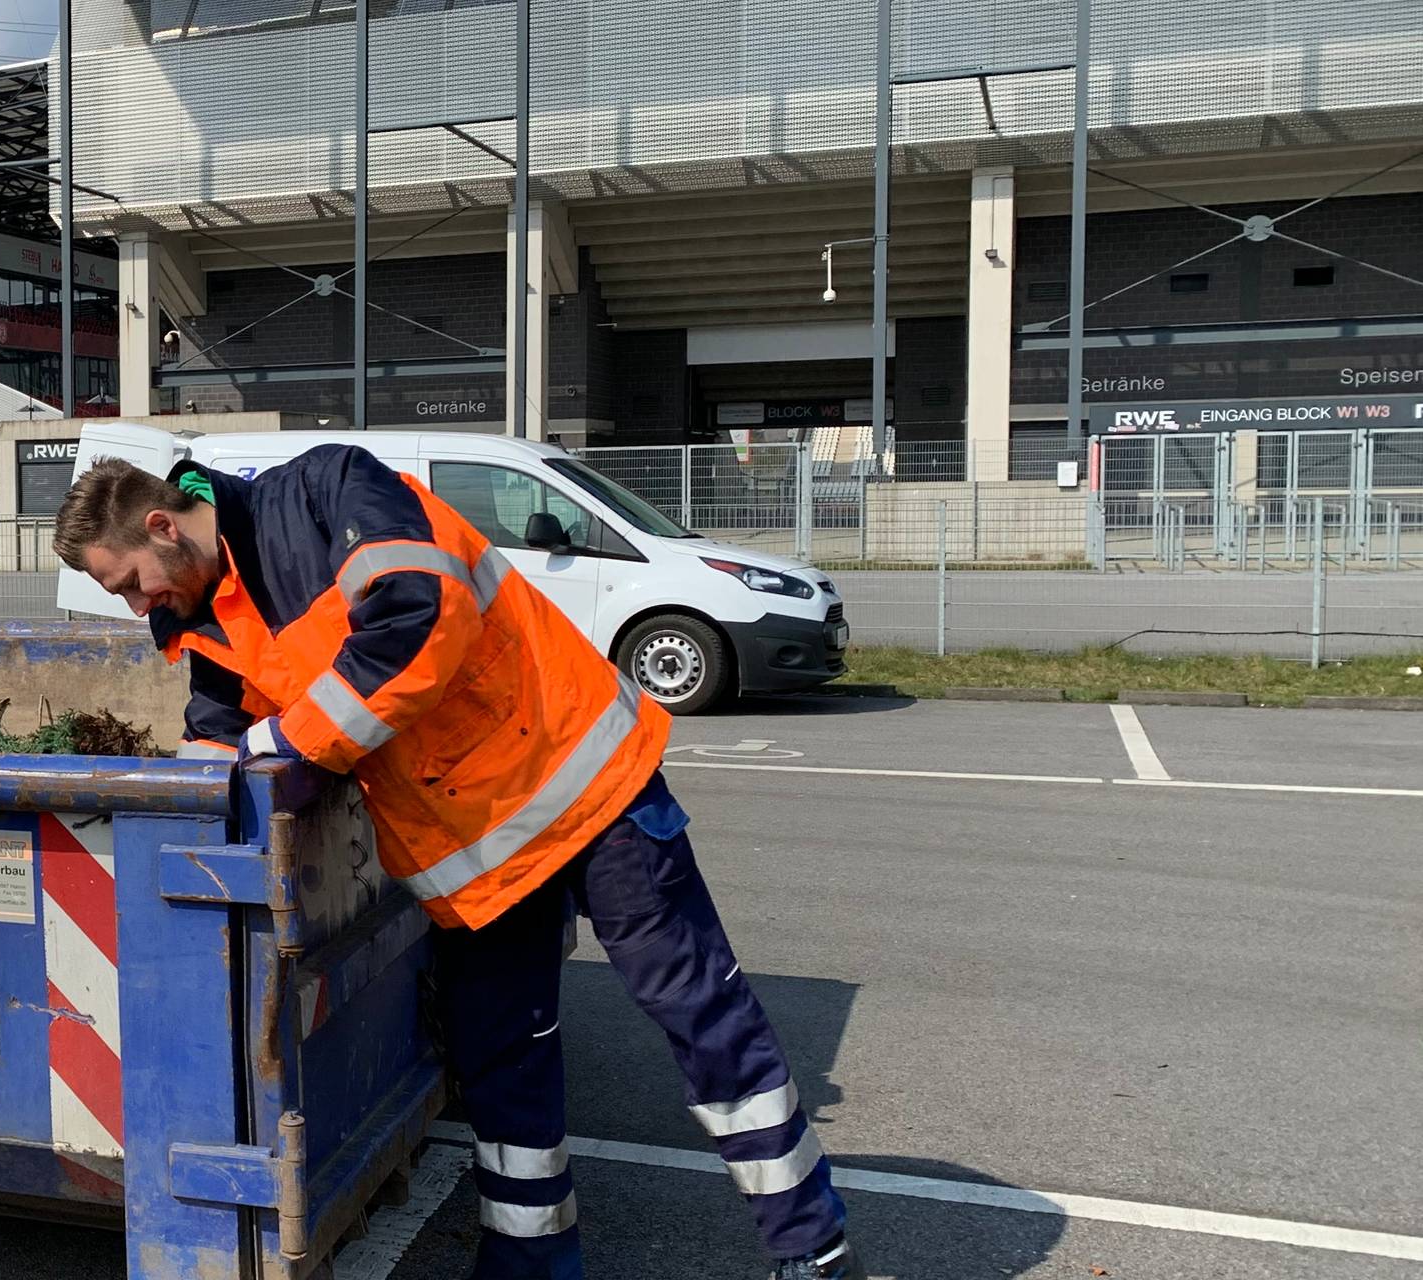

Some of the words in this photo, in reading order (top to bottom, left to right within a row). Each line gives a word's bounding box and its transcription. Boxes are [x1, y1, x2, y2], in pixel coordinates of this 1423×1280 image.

[417, 400, 486, 415] Getränke
[768, 406, 813, 418] BLOCK
[821, 406, 841, 417] W3
[1115, 410, 1176, 427] RWE
[1201, 408, 1273, 422] EINGANG
[1277, 407, 1331, 421] BLOCK
[1337, 406, 1359, 418] W1
[1365, 404, 1391, 418] W3
[34, 444, 78, 458] RWE
